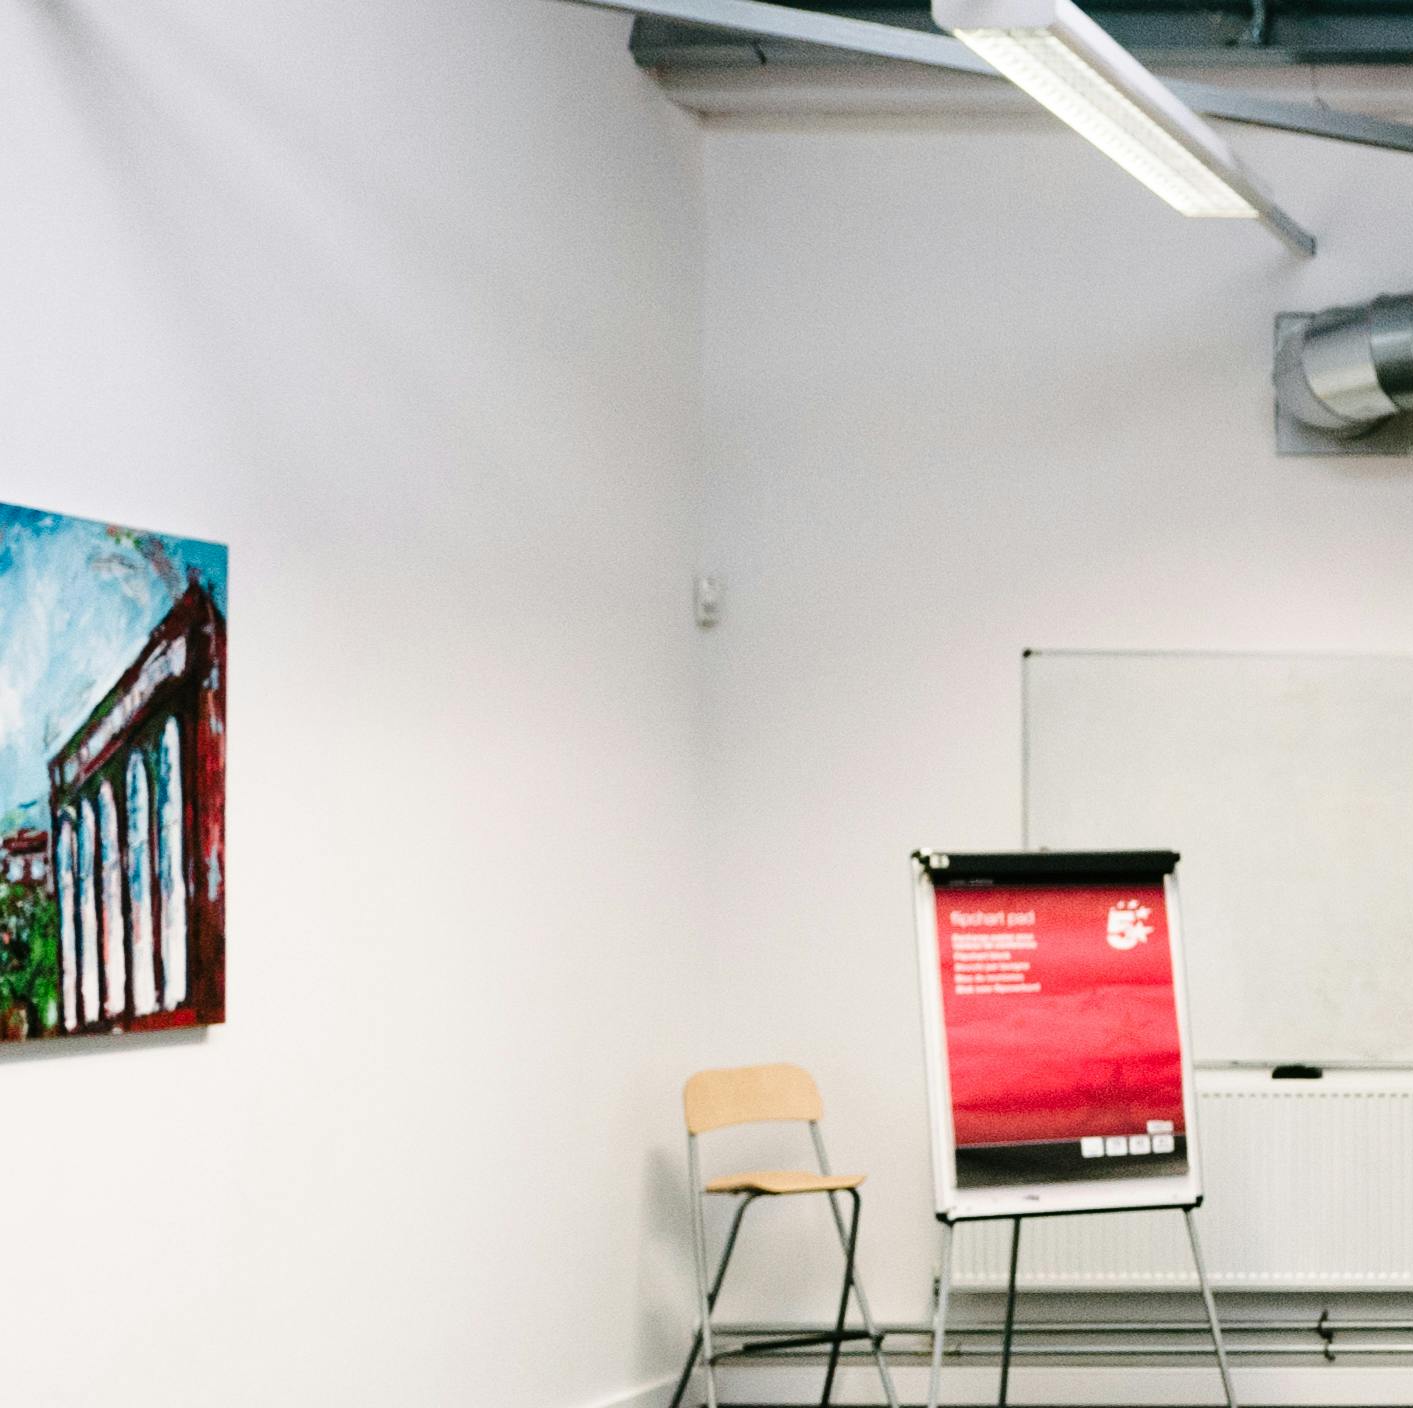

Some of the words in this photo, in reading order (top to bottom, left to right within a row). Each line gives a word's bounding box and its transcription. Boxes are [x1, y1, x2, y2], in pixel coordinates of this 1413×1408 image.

[950, 910, 1006, 929] flipchart
[1007, 910, 1036, 929] pad
[1107, 907, 1139, 950] 5
